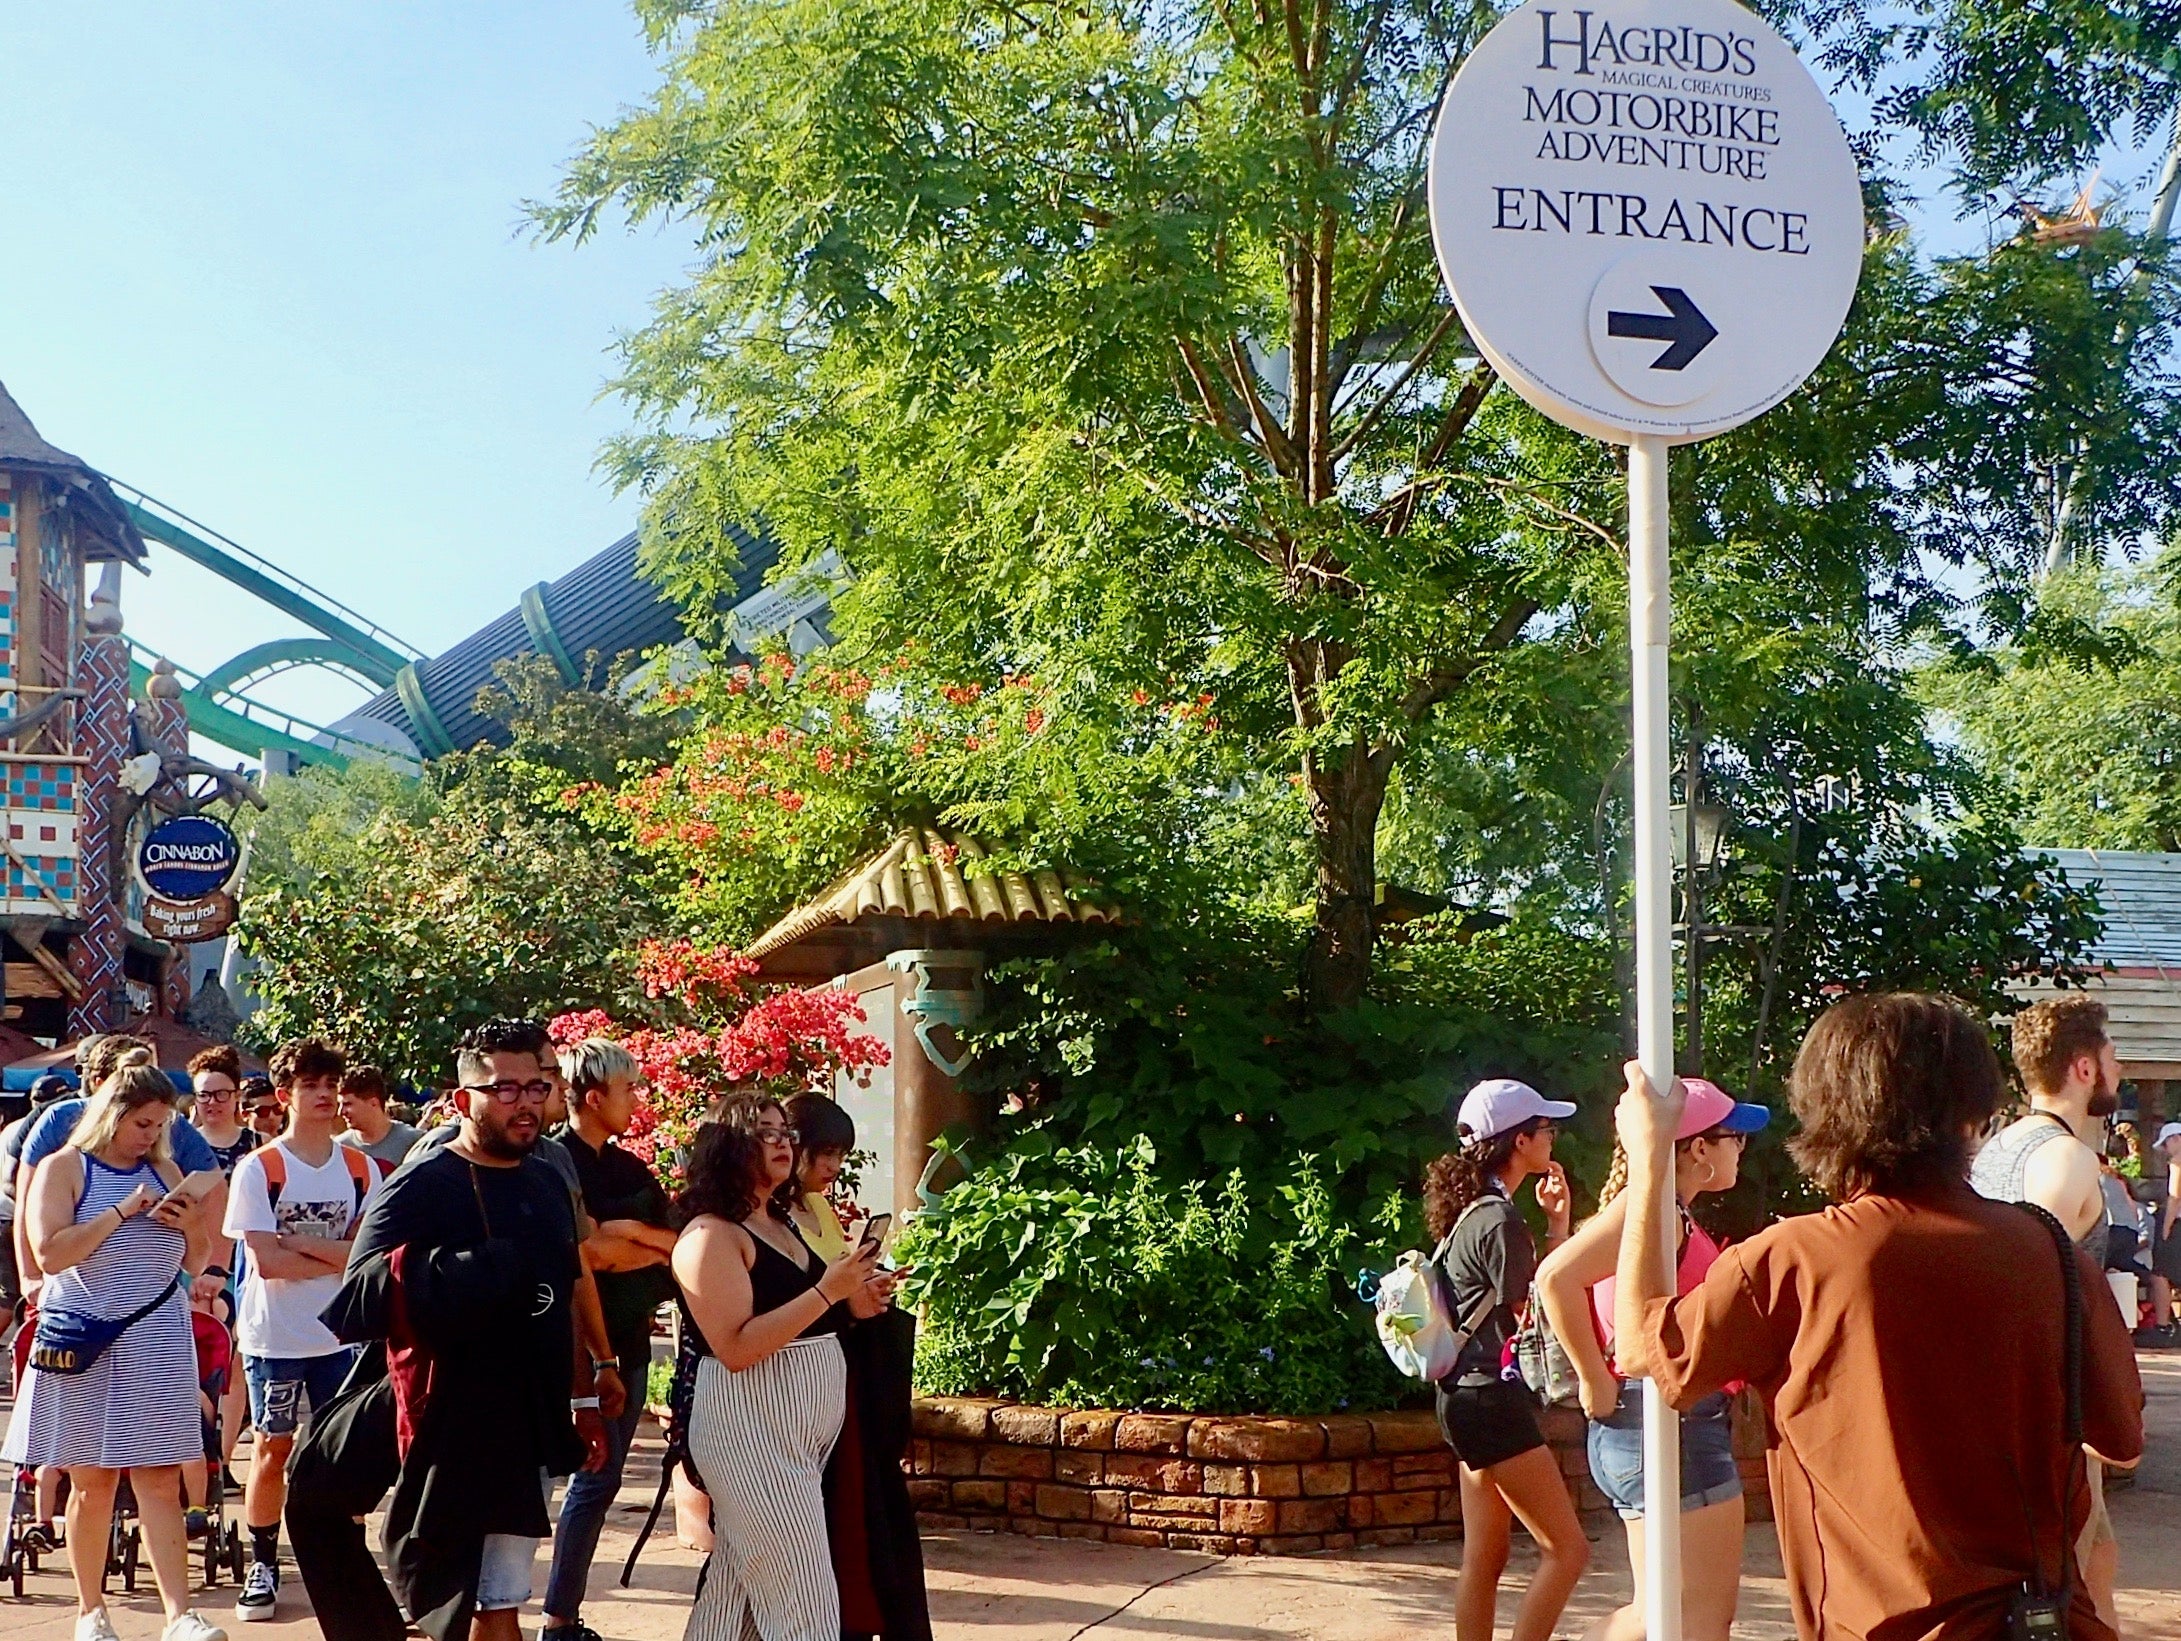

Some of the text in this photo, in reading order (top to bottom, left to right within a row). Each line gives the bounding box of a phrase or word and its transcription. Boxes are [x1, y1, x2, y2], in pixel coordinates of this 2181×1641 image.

[1536, 10, 1756, 76] HAGRID'S
[1602, 70, 1771, 102] MAGICAL CREATURES
[1522, 86, 1781, 146] MOTORBIKE
[1492, 186, 1811, 255] ENTRANCE
[146, 841, 223, 862] CINNABON
[150, 903, 216, 924] Baking yours fresh
[163, 923, 182, 938] right
